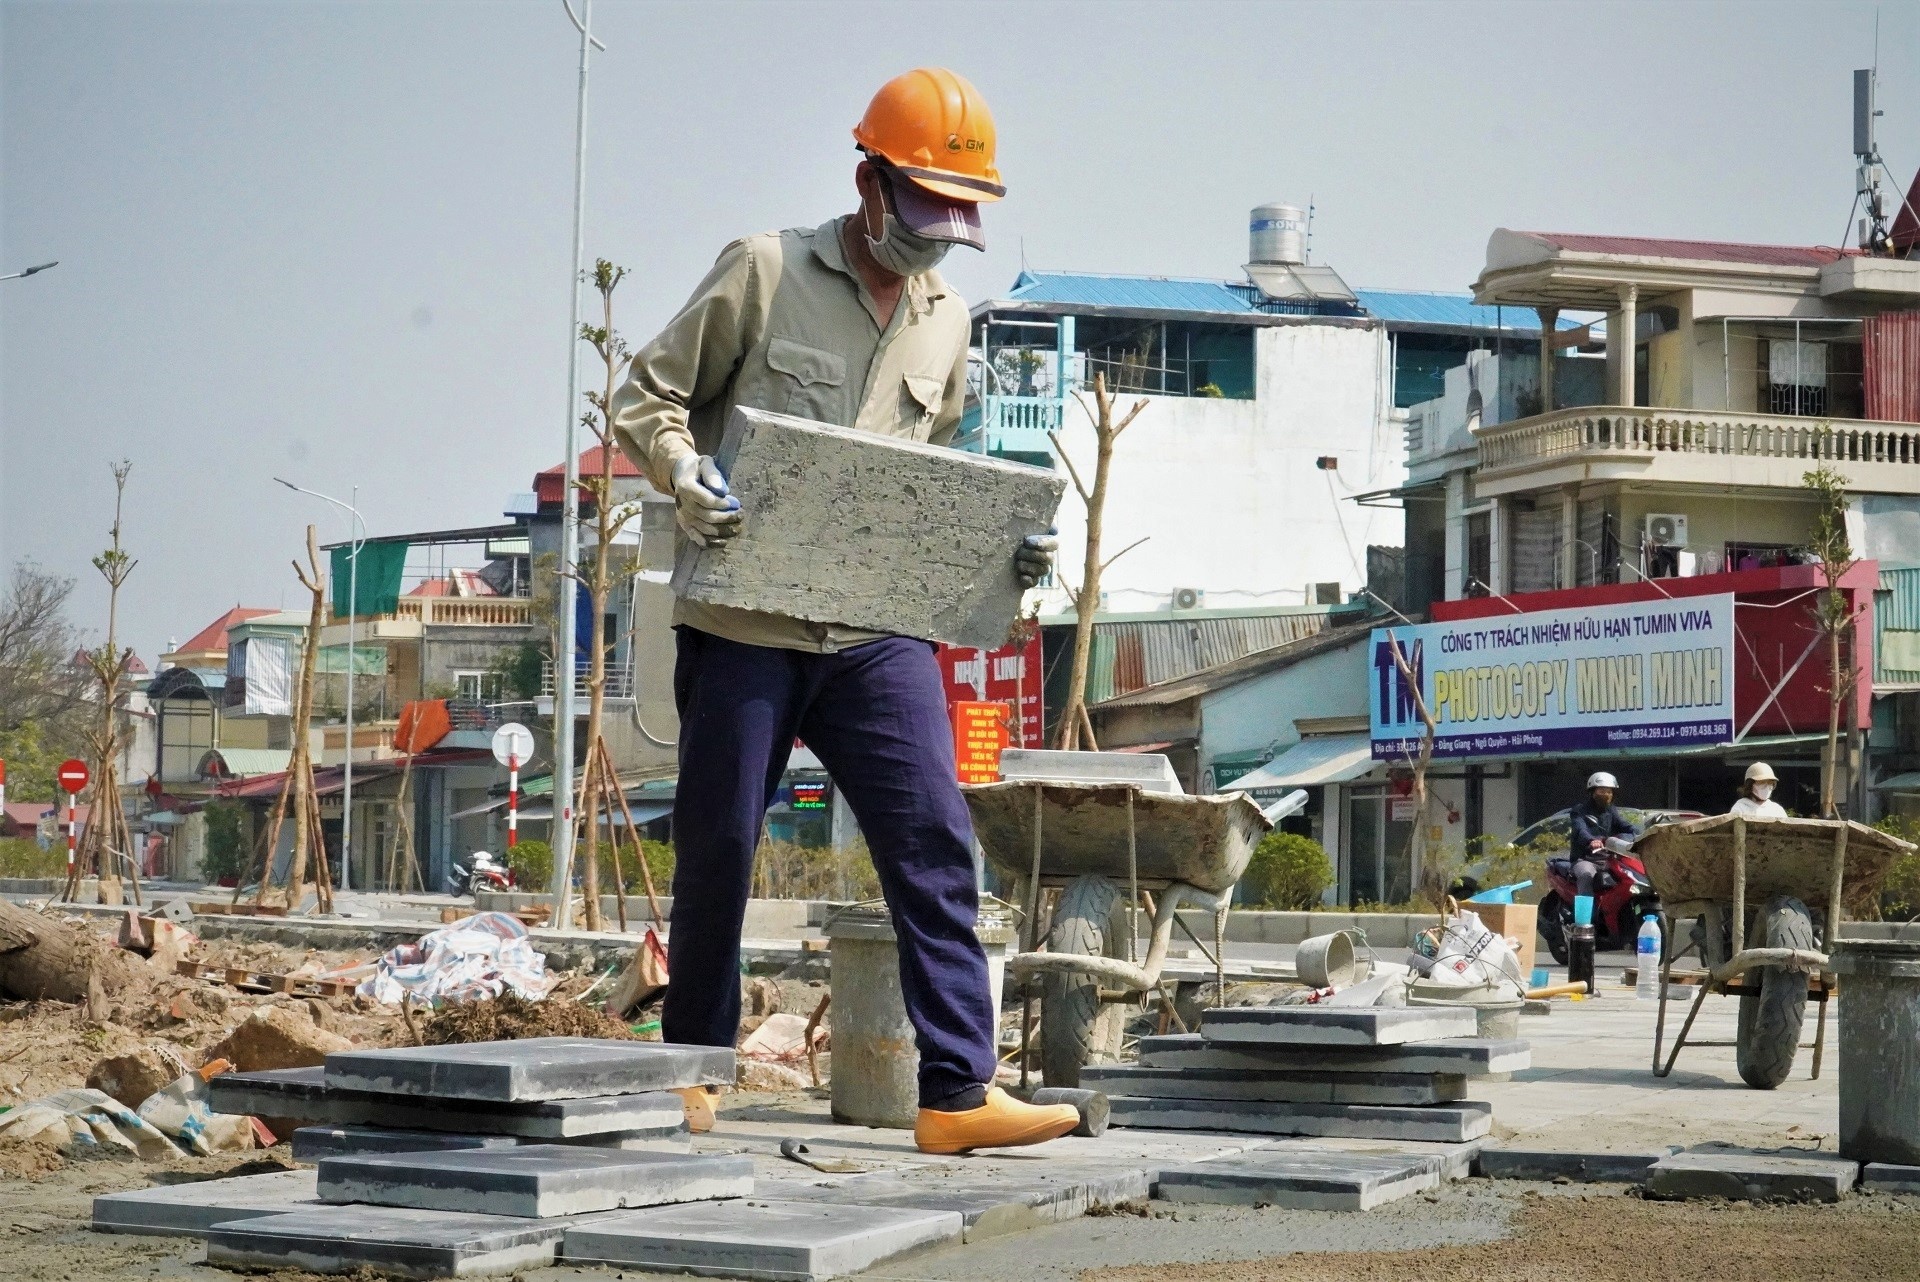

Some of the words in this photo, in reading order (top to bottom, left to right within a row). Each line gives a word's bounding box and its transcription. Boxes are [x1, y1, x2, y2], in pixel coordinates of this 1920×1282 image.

[966, 139, 985, 151] GM
[1441, 630, 1472, 653] CÔNG
[1474, 631, 1488, 650] TY
[1490, 624, 1529, 648] TRÁCH
[1531, 619, 1571, 647] NHIỆM
[1574, 617, 1600, 641] HỮU
[1604, 618, 1631, 642] HẠN
[1633, 613, 1677, 635] TUMIN
[1680, 610, 1713, 632] VIVA
[1374, 638, 1425, 728] TM
[1433, 658, 1568, 725] PHOTOCOPY
[1575, 653, 1644, 714] MINH
[1650, 647, 1723, 710] MINH
[1454, 739, 1471, 751] Giang
[1607, 728, 1632, 740] Hotline:
